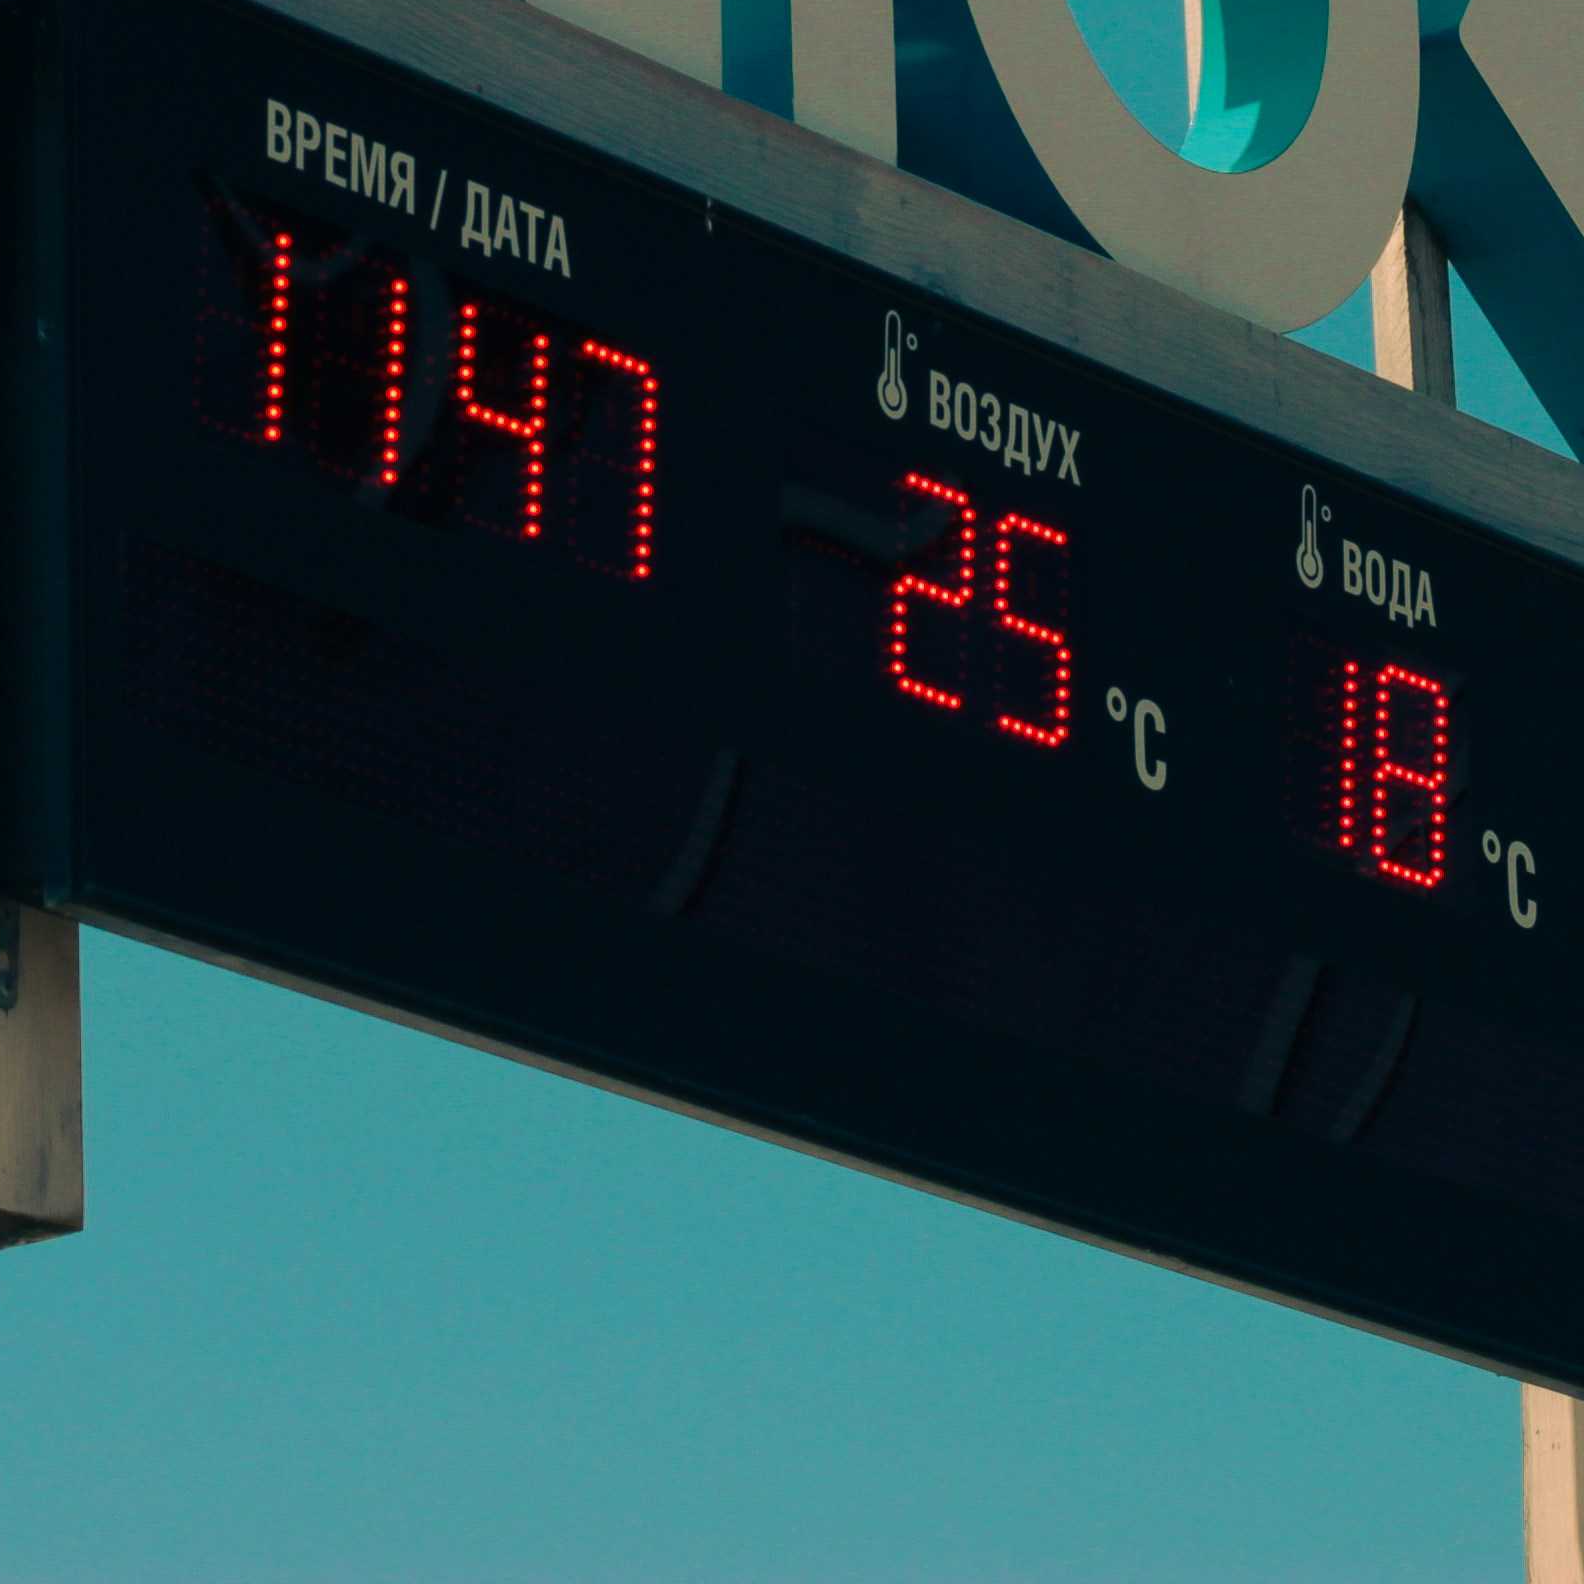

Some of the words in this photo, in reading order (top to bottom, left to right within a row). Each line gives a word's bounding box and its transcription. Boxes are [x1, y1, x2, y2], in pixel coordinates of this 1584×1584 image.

[266, 97, 416, 215] ВРЕМЯ
[429, 169, 449, 231] /
[460, 179, 572, 279] ДАТА
[928, 369, 1082, 487] ВОЗДУХ
[890, 471, 1072, 748] 25
[1342, 538, 1438, 629] ВОДА
[1338, 661, 1449, 889] 18
